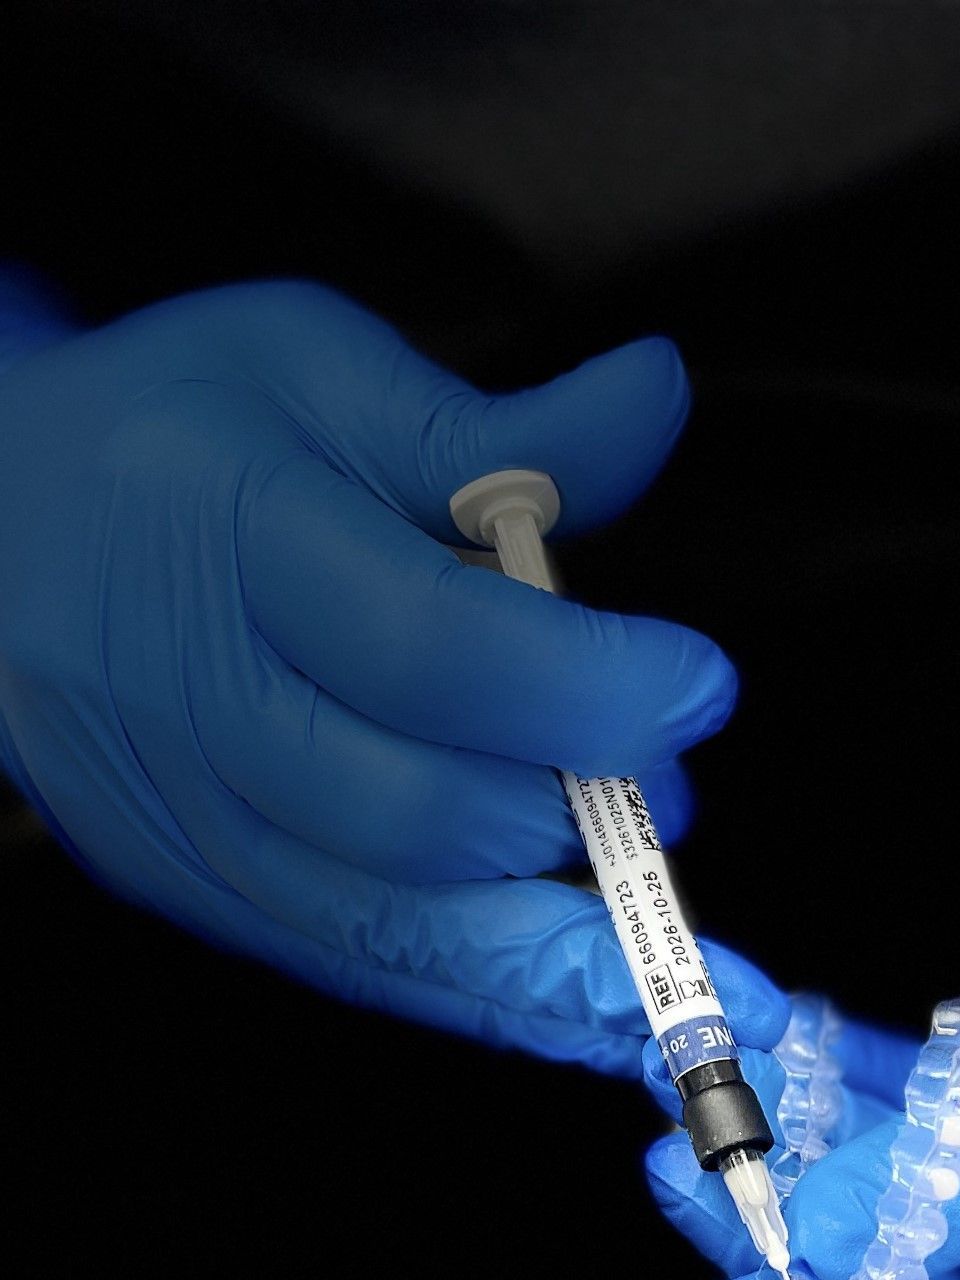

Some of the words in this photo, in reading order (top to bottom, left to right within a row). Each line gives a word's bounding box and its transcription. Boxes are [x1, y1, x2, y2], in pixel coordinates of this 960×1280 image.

[615, 880, 656, 965] 66094723
[642, 871, 691, 966] 2026-10-25
[650, 973, 675, 1008] REF
[670, 1034, 689, 1054] 20
